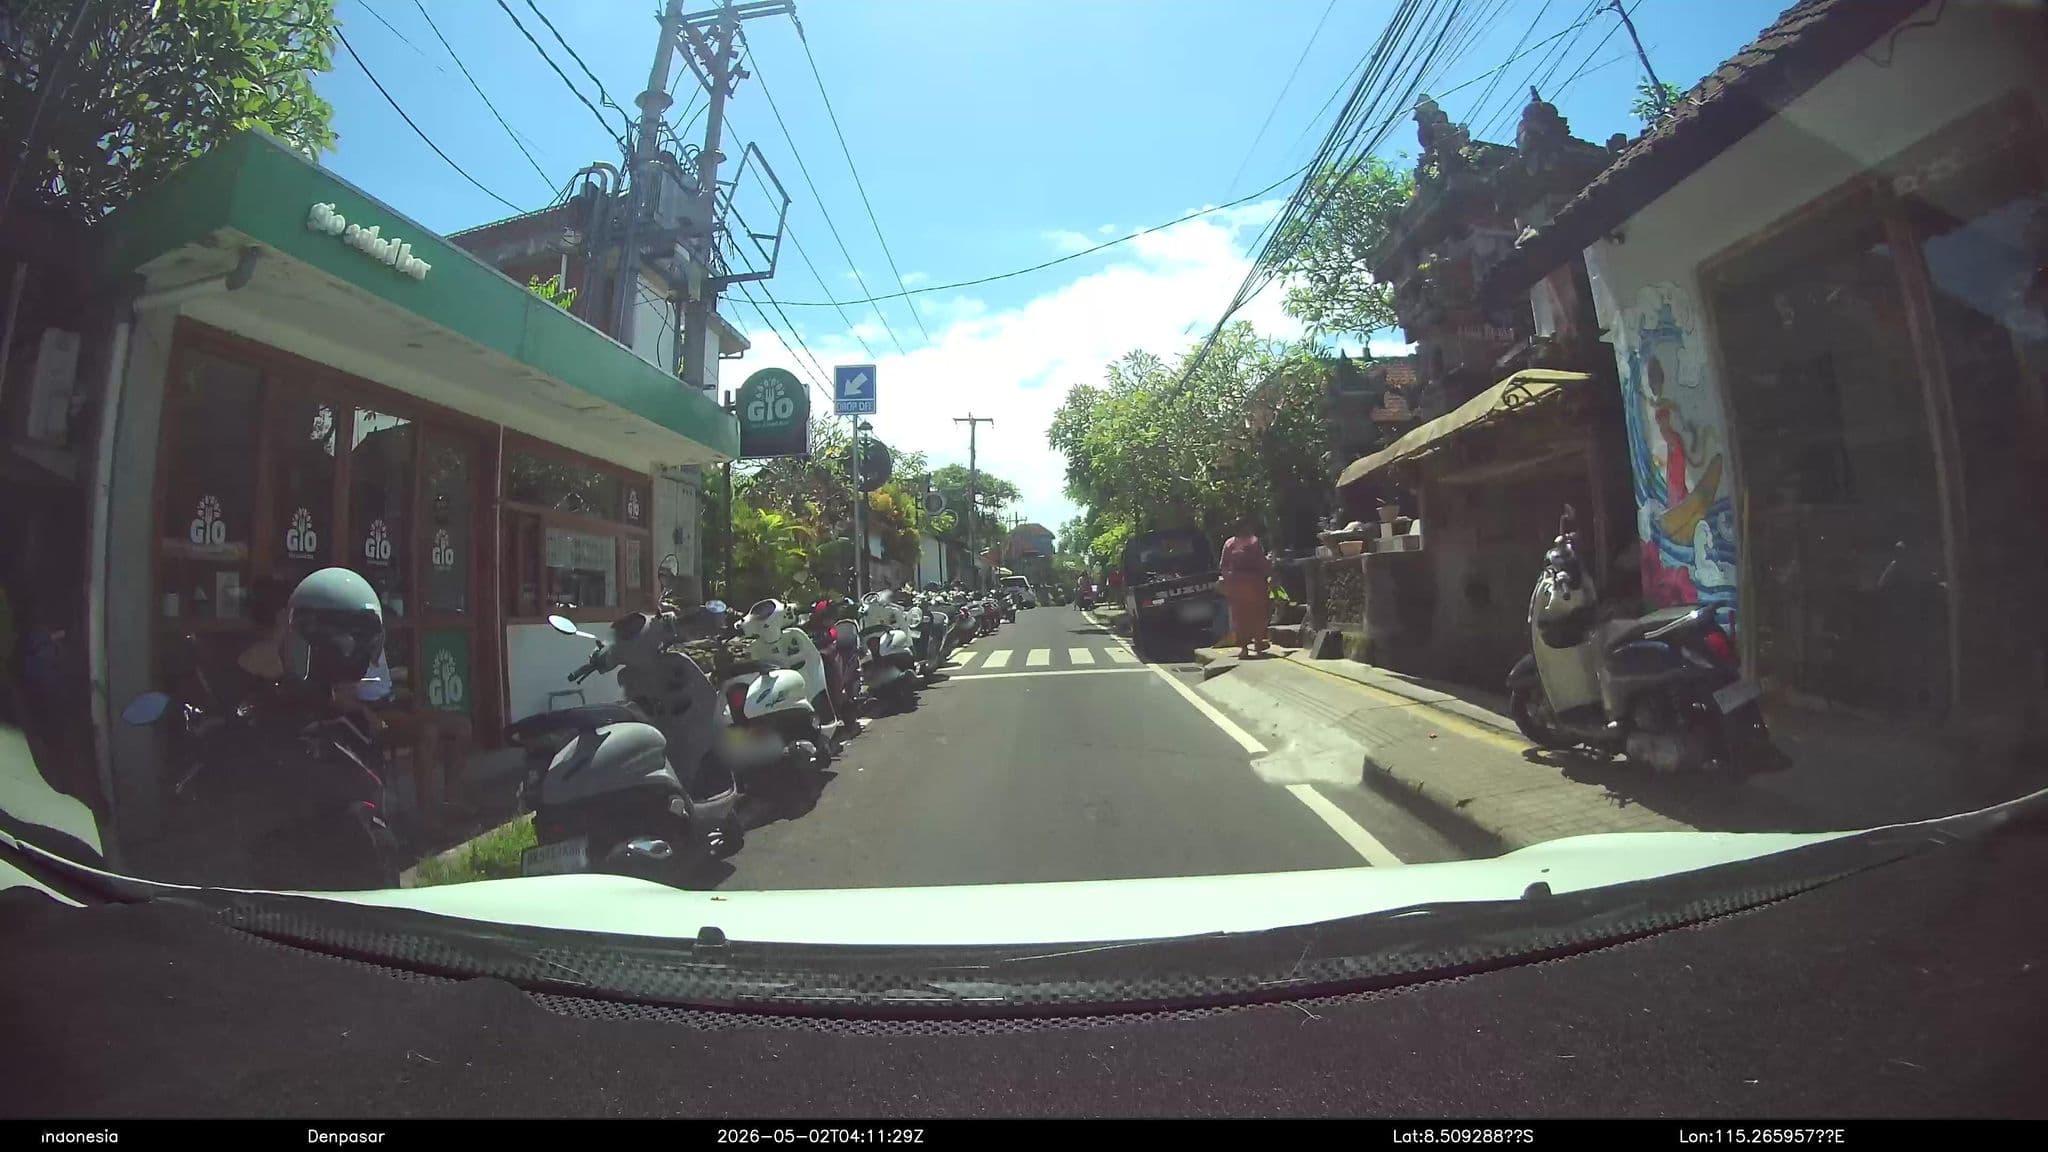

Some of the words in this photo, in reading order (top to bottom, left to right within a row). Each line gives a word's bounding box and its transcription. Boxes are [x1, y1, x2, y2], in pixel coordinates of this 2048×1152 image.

[343, 223, 402, 266] salad
[396, 243, 432, 280] bar
[747, 393, 794, 421] GIO
[837, 401, 858, 412] DROP
[190, 512, 227, 545] GIO
[286, 522, 318, 553] GIO
[365, 533, 391, 560] GIO
[432, 542, 454, 566] GIO
[429, 671, 463, 705] GIO
